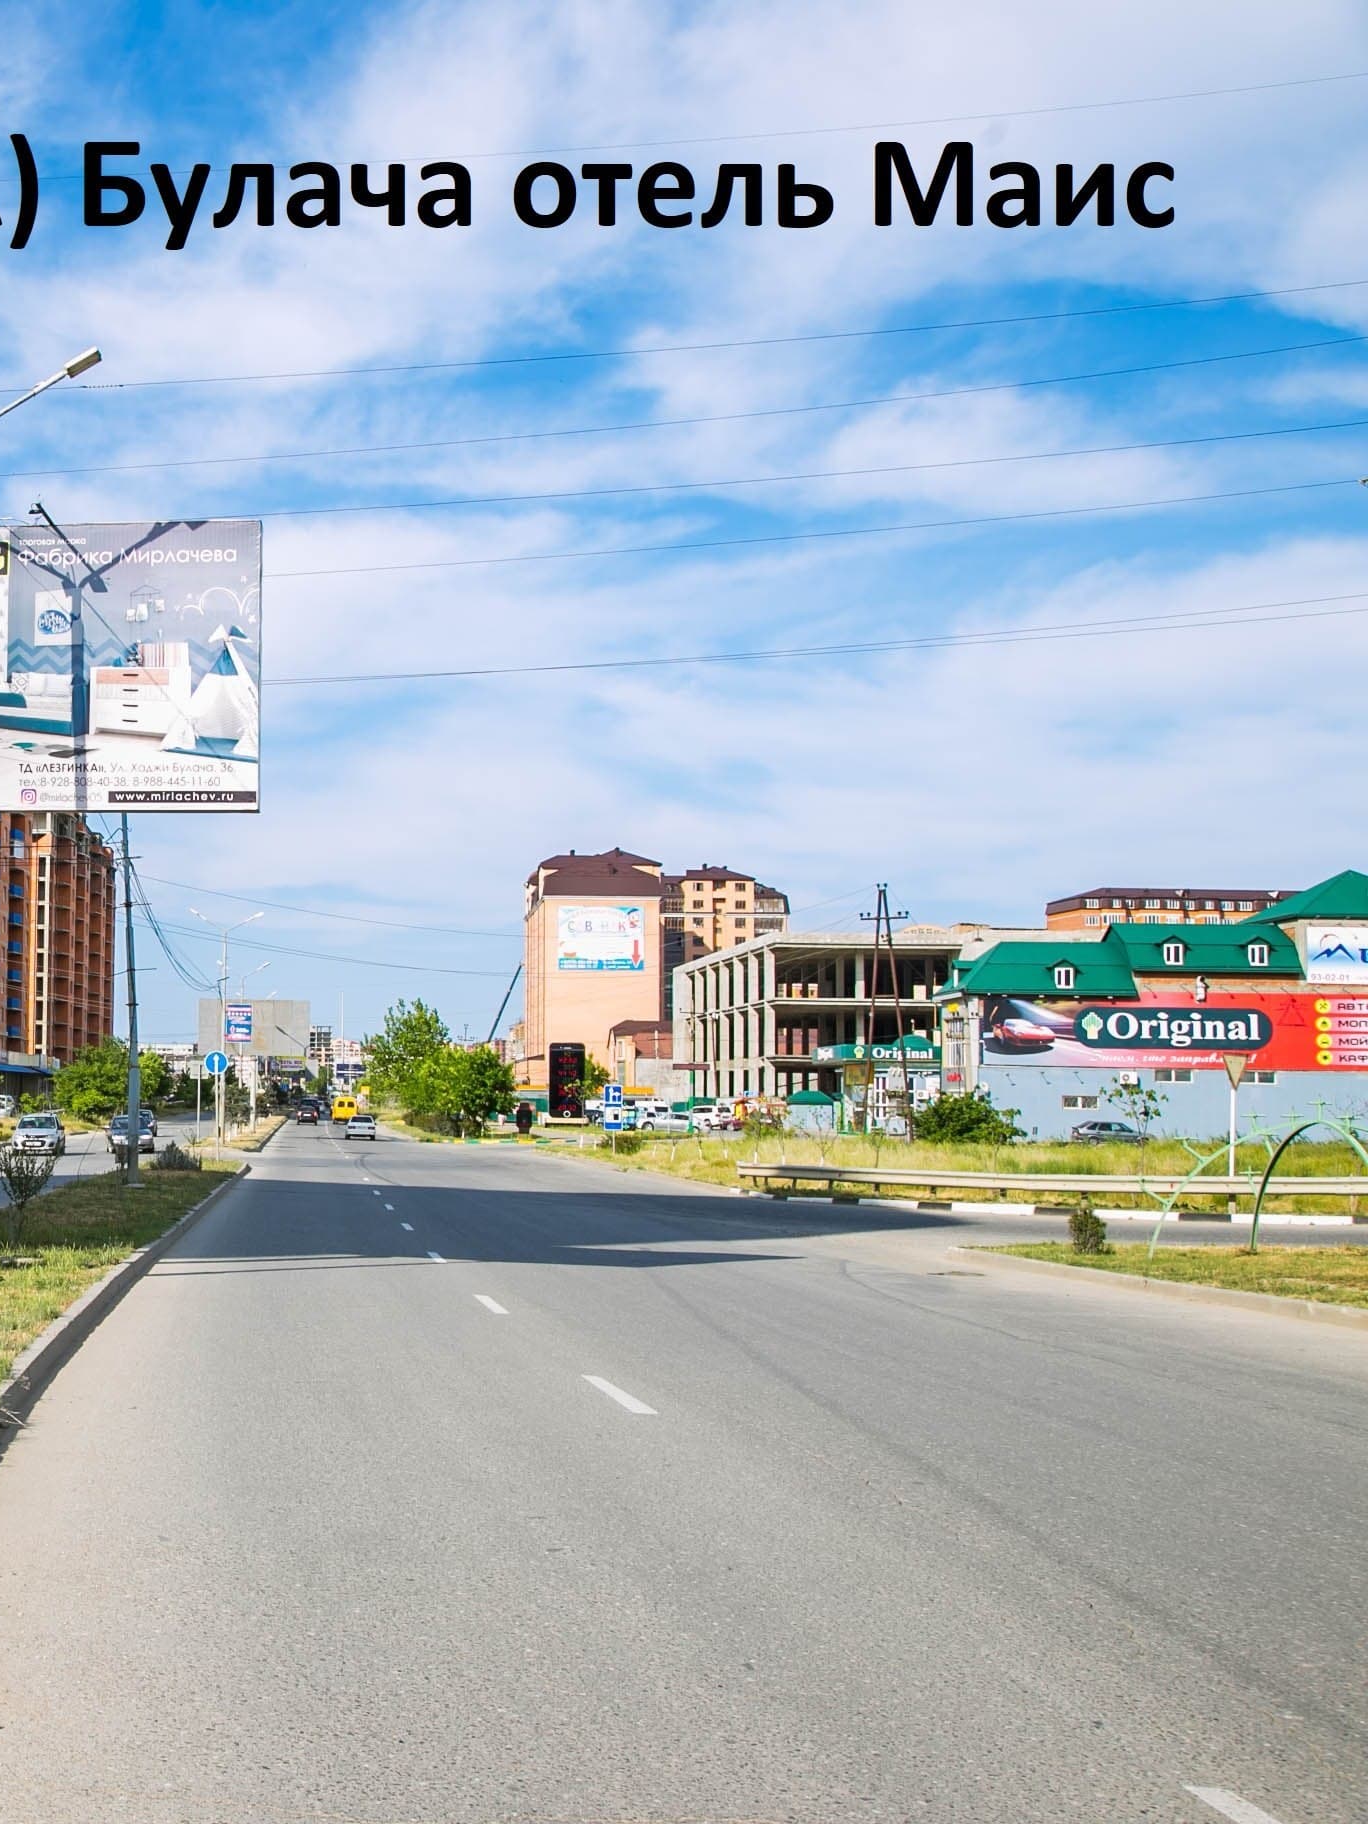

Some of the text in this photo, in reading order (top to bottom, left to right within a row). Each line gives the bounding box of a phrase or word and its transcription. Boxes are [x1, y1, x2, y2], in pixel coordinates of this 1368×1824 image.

[17, 547, 237, 569] Фабрика Мирлачева
[18, 763, 33, 773] ТД
[131, 763, 169, 773] Хаджи
[220, 762, 234, 773] 36
[132, 777, 221, 787] 8-988-445-11-60
[115, 791, 234, 801] www.mirlachev.ru
[1106, 1012, 1261, 1047] Original
